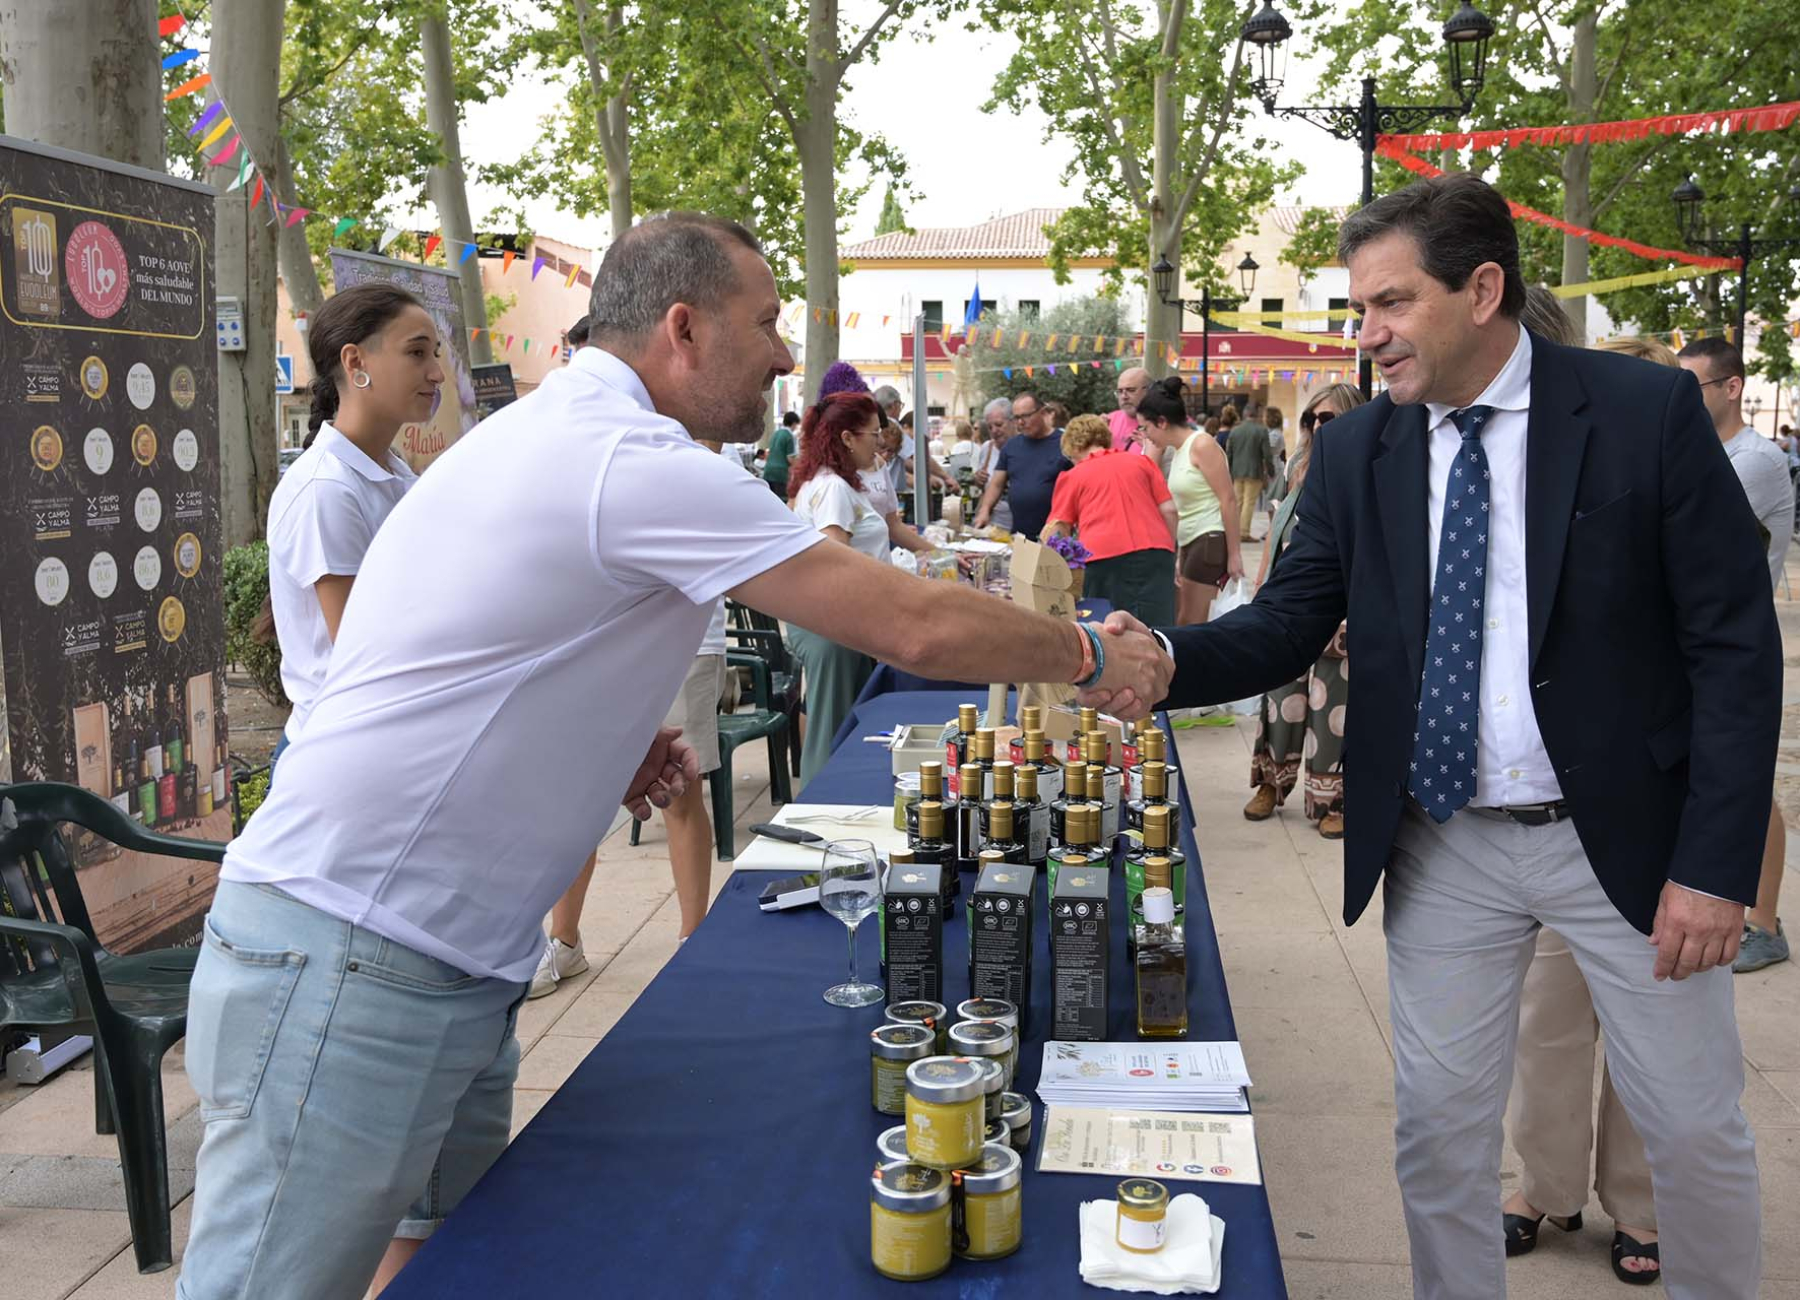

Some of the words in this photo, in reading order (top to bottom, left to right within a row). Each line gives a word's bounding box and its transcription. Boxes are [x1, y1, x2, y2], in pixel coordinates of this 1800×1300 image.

[138, 255, 158, 269] TOP
[159, 258, 166, 270] 6
[167, 260, 190, 274] AOVE
[136, 271, 154, 285] más
[154, 274, 194, 290] saludable
[20, 281, 58, 301] EVOOLEUM
[141, 288, 159, 302] DEL
[160, 291, 193, 306] MUNDO
[38, 376, 59, 384] CAMPO
[403, 425, 445, 455] María
[99, 495, 120, 504] CAMPO
[186, 490, 202, 499] CAMPO
[48, 510, 70, 519] CAMPO
[77, 621, 99, 632] CAMPO
[125, 620, 145, 630] CAMPO
